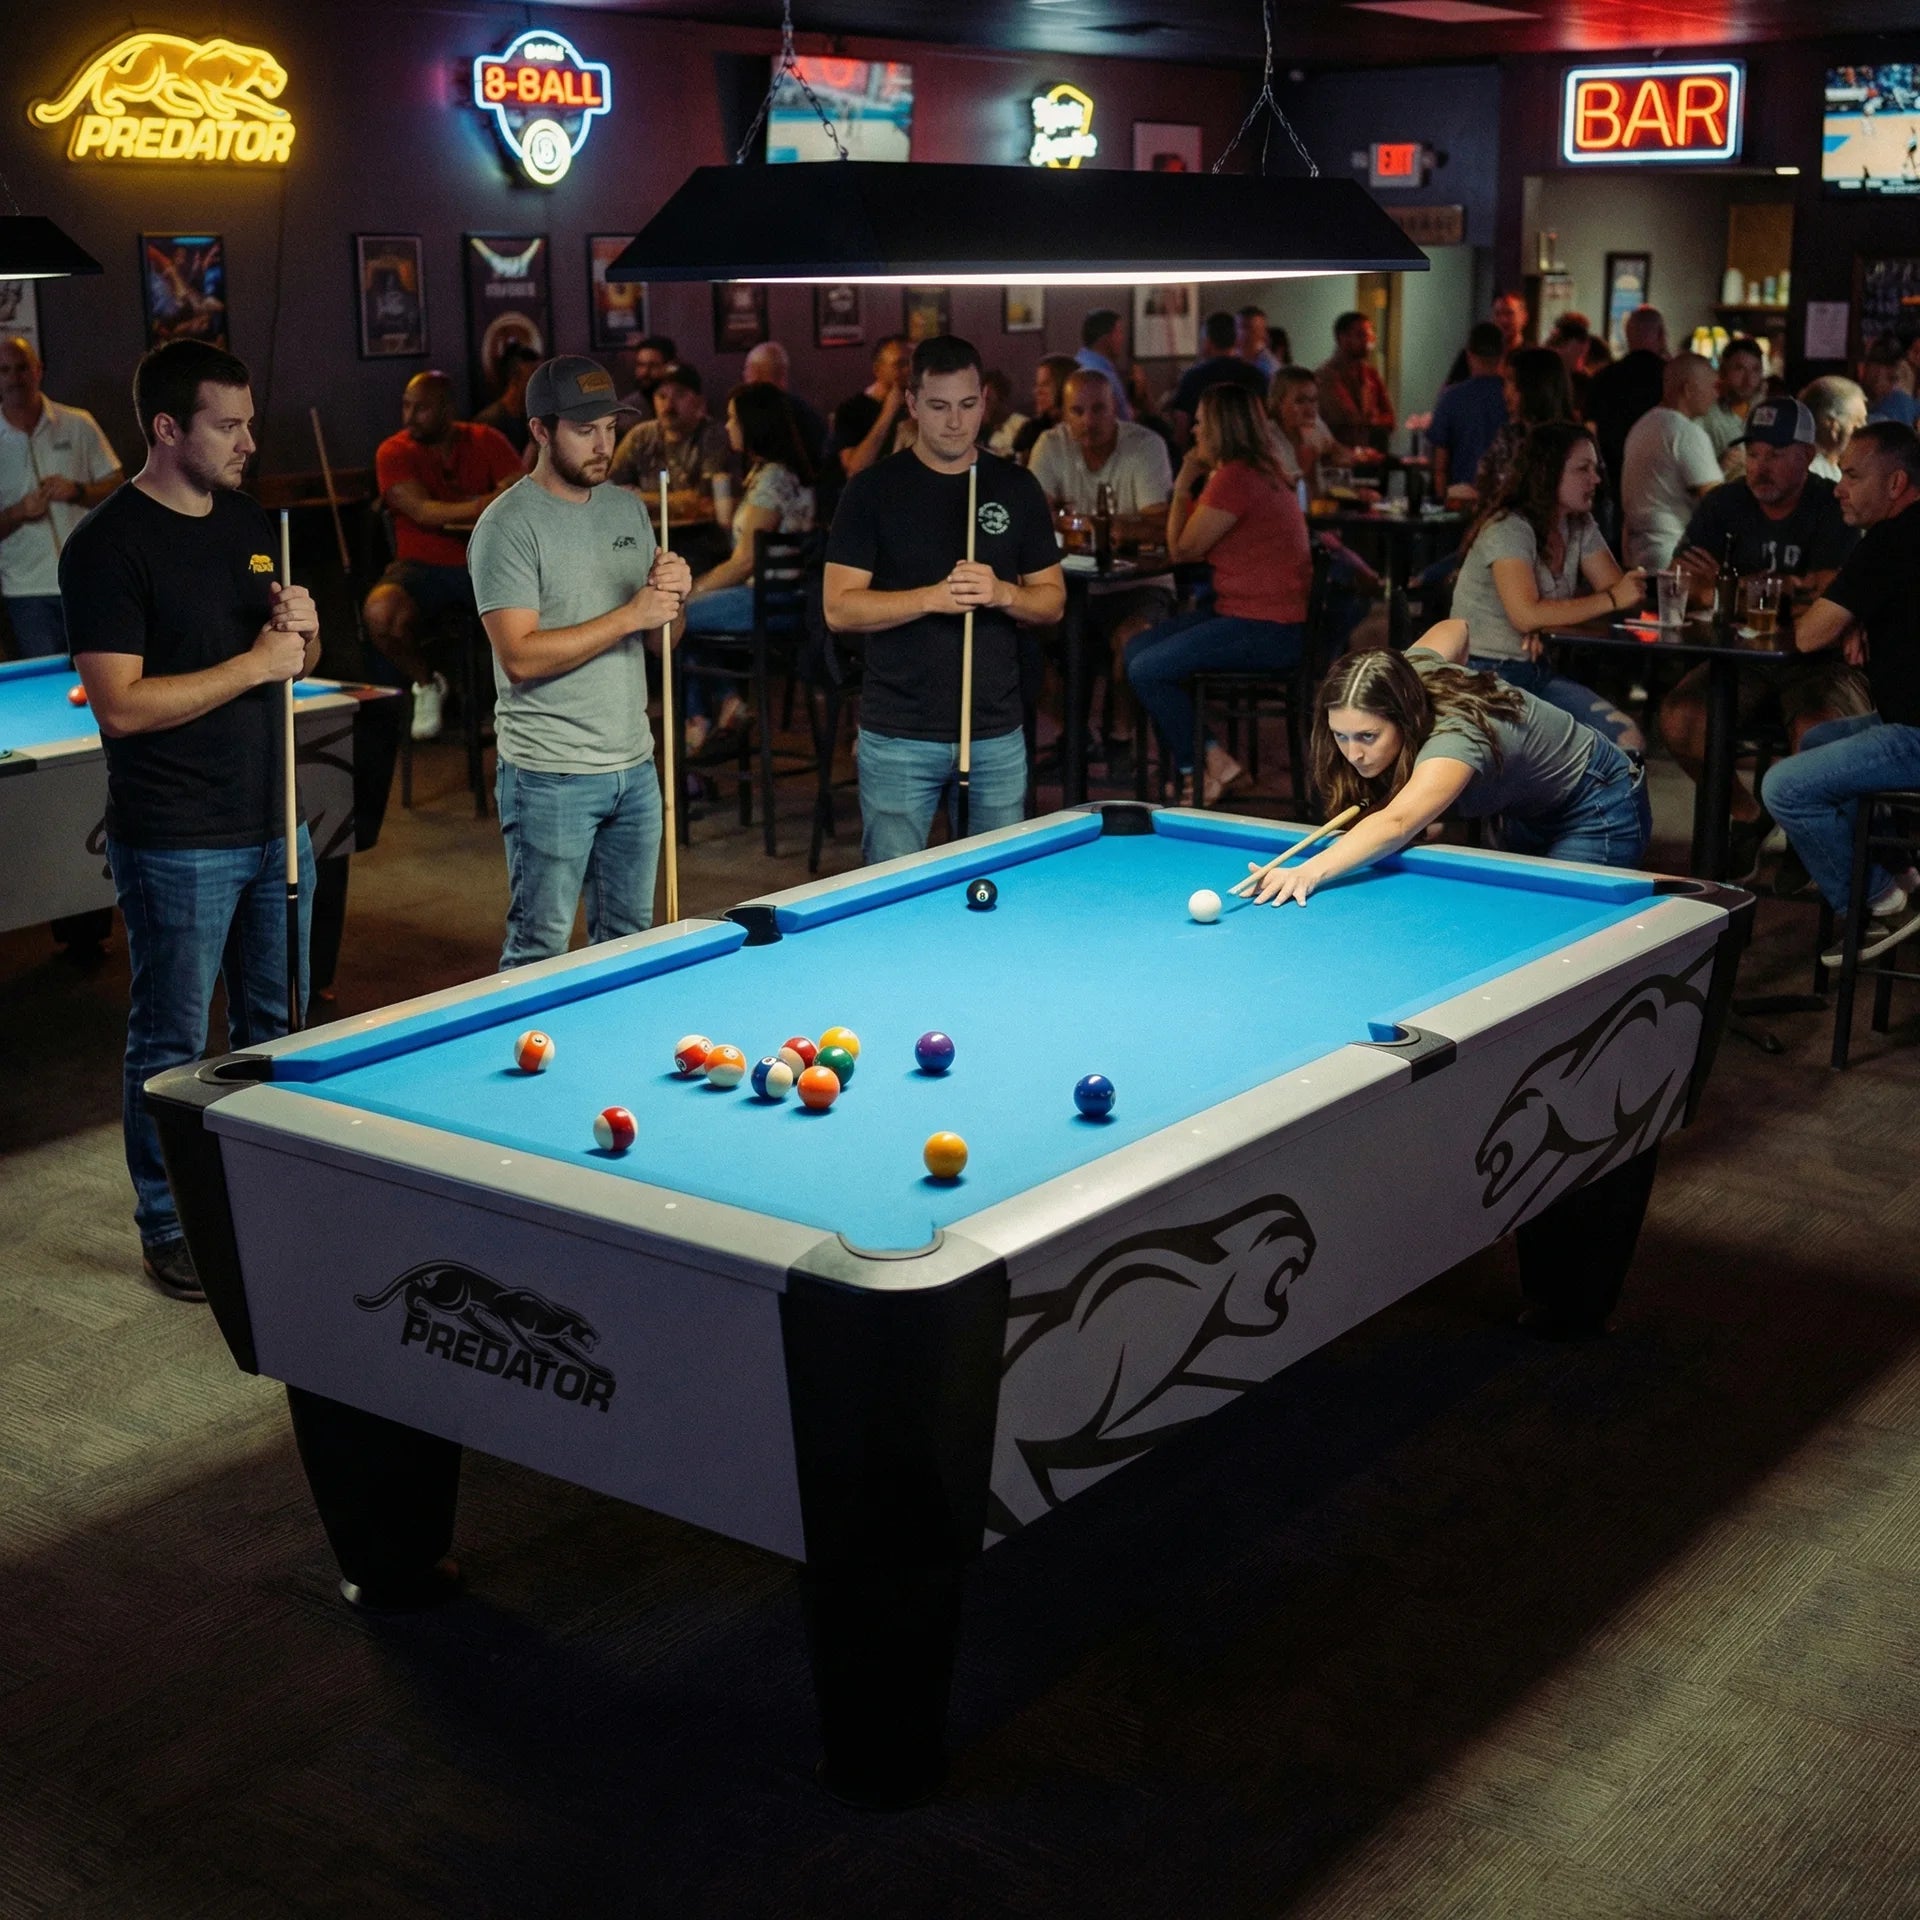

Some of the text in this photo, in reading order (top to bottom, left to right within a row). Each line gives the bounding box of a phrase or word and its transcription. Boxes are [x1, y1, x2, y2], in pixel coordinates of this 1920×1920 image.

[484, 66, 602, 105] 8-BALL
[1576, 78, 1726, 148] BAR
[73, 115, 296, 163] PREDATOR
[400, 1313, 616, 1413] PREDATOR
